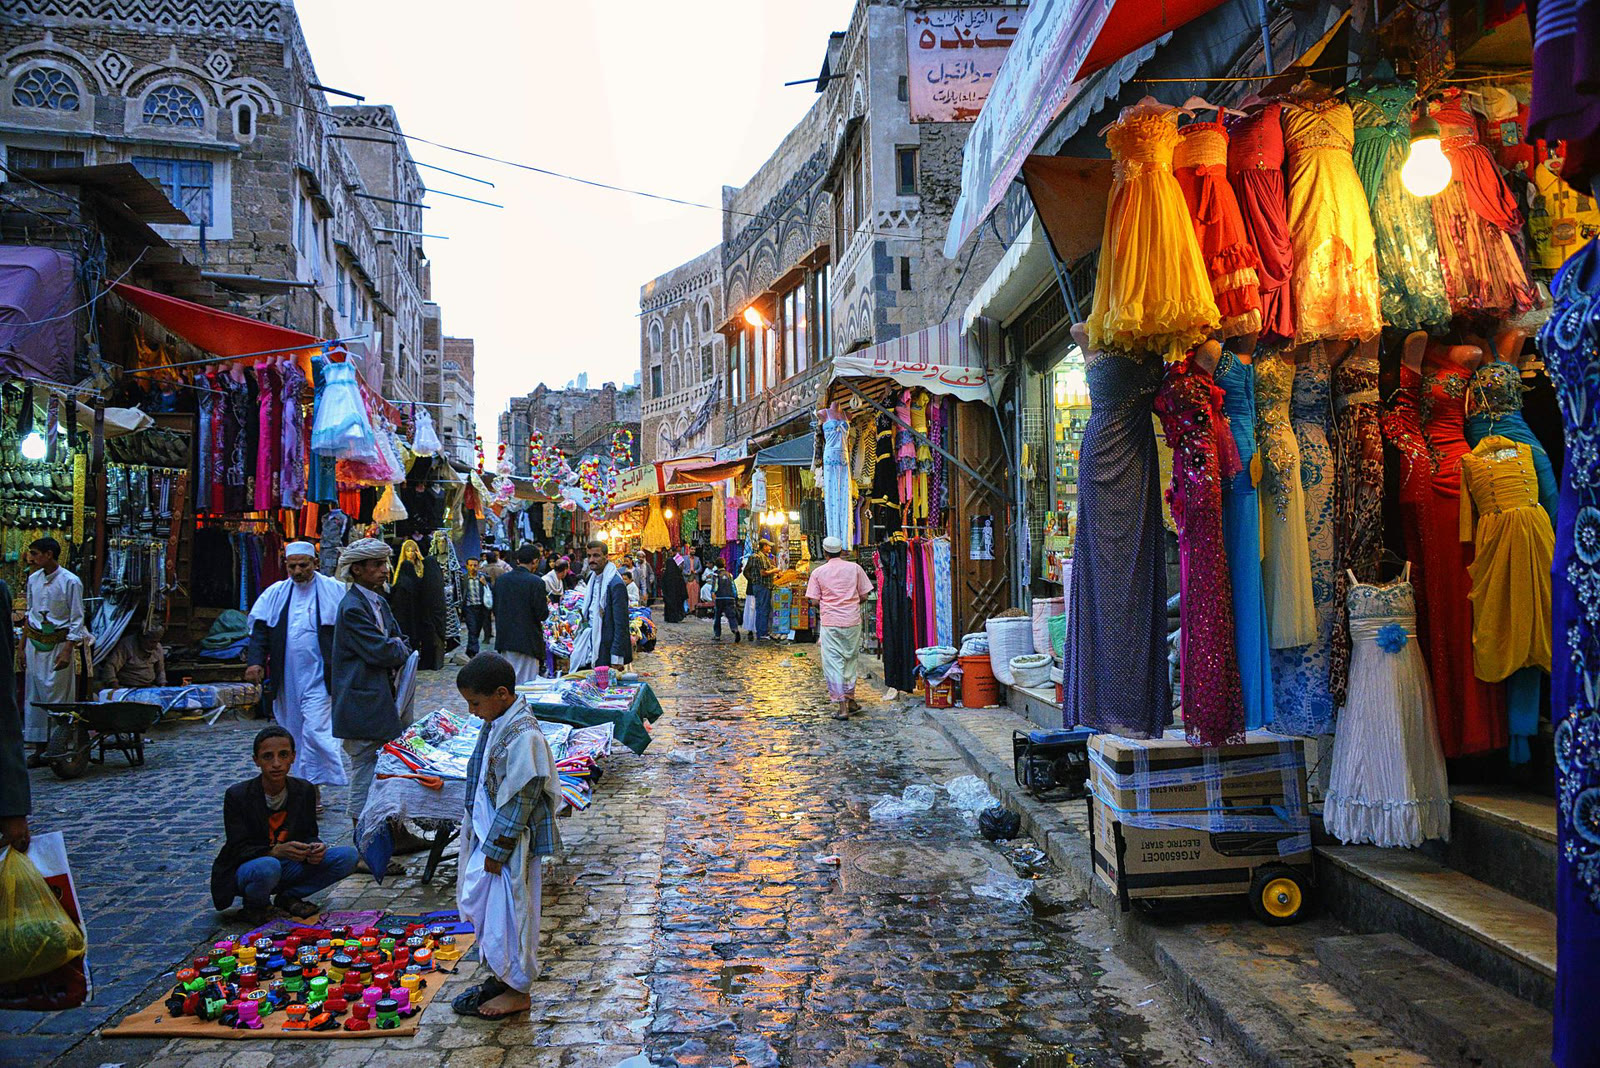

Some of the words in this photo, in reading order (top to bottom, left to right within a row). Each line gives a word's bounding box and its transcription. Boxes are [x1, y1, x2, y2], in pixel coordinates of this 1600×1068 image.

[1168, 784, 1197, 793] GERMAN
[1141, 840, 1164, 850] START
[1166, 839, 1201, 849] ELECTRIC
[1141, 850, 1201, 863] ATG6500CET
